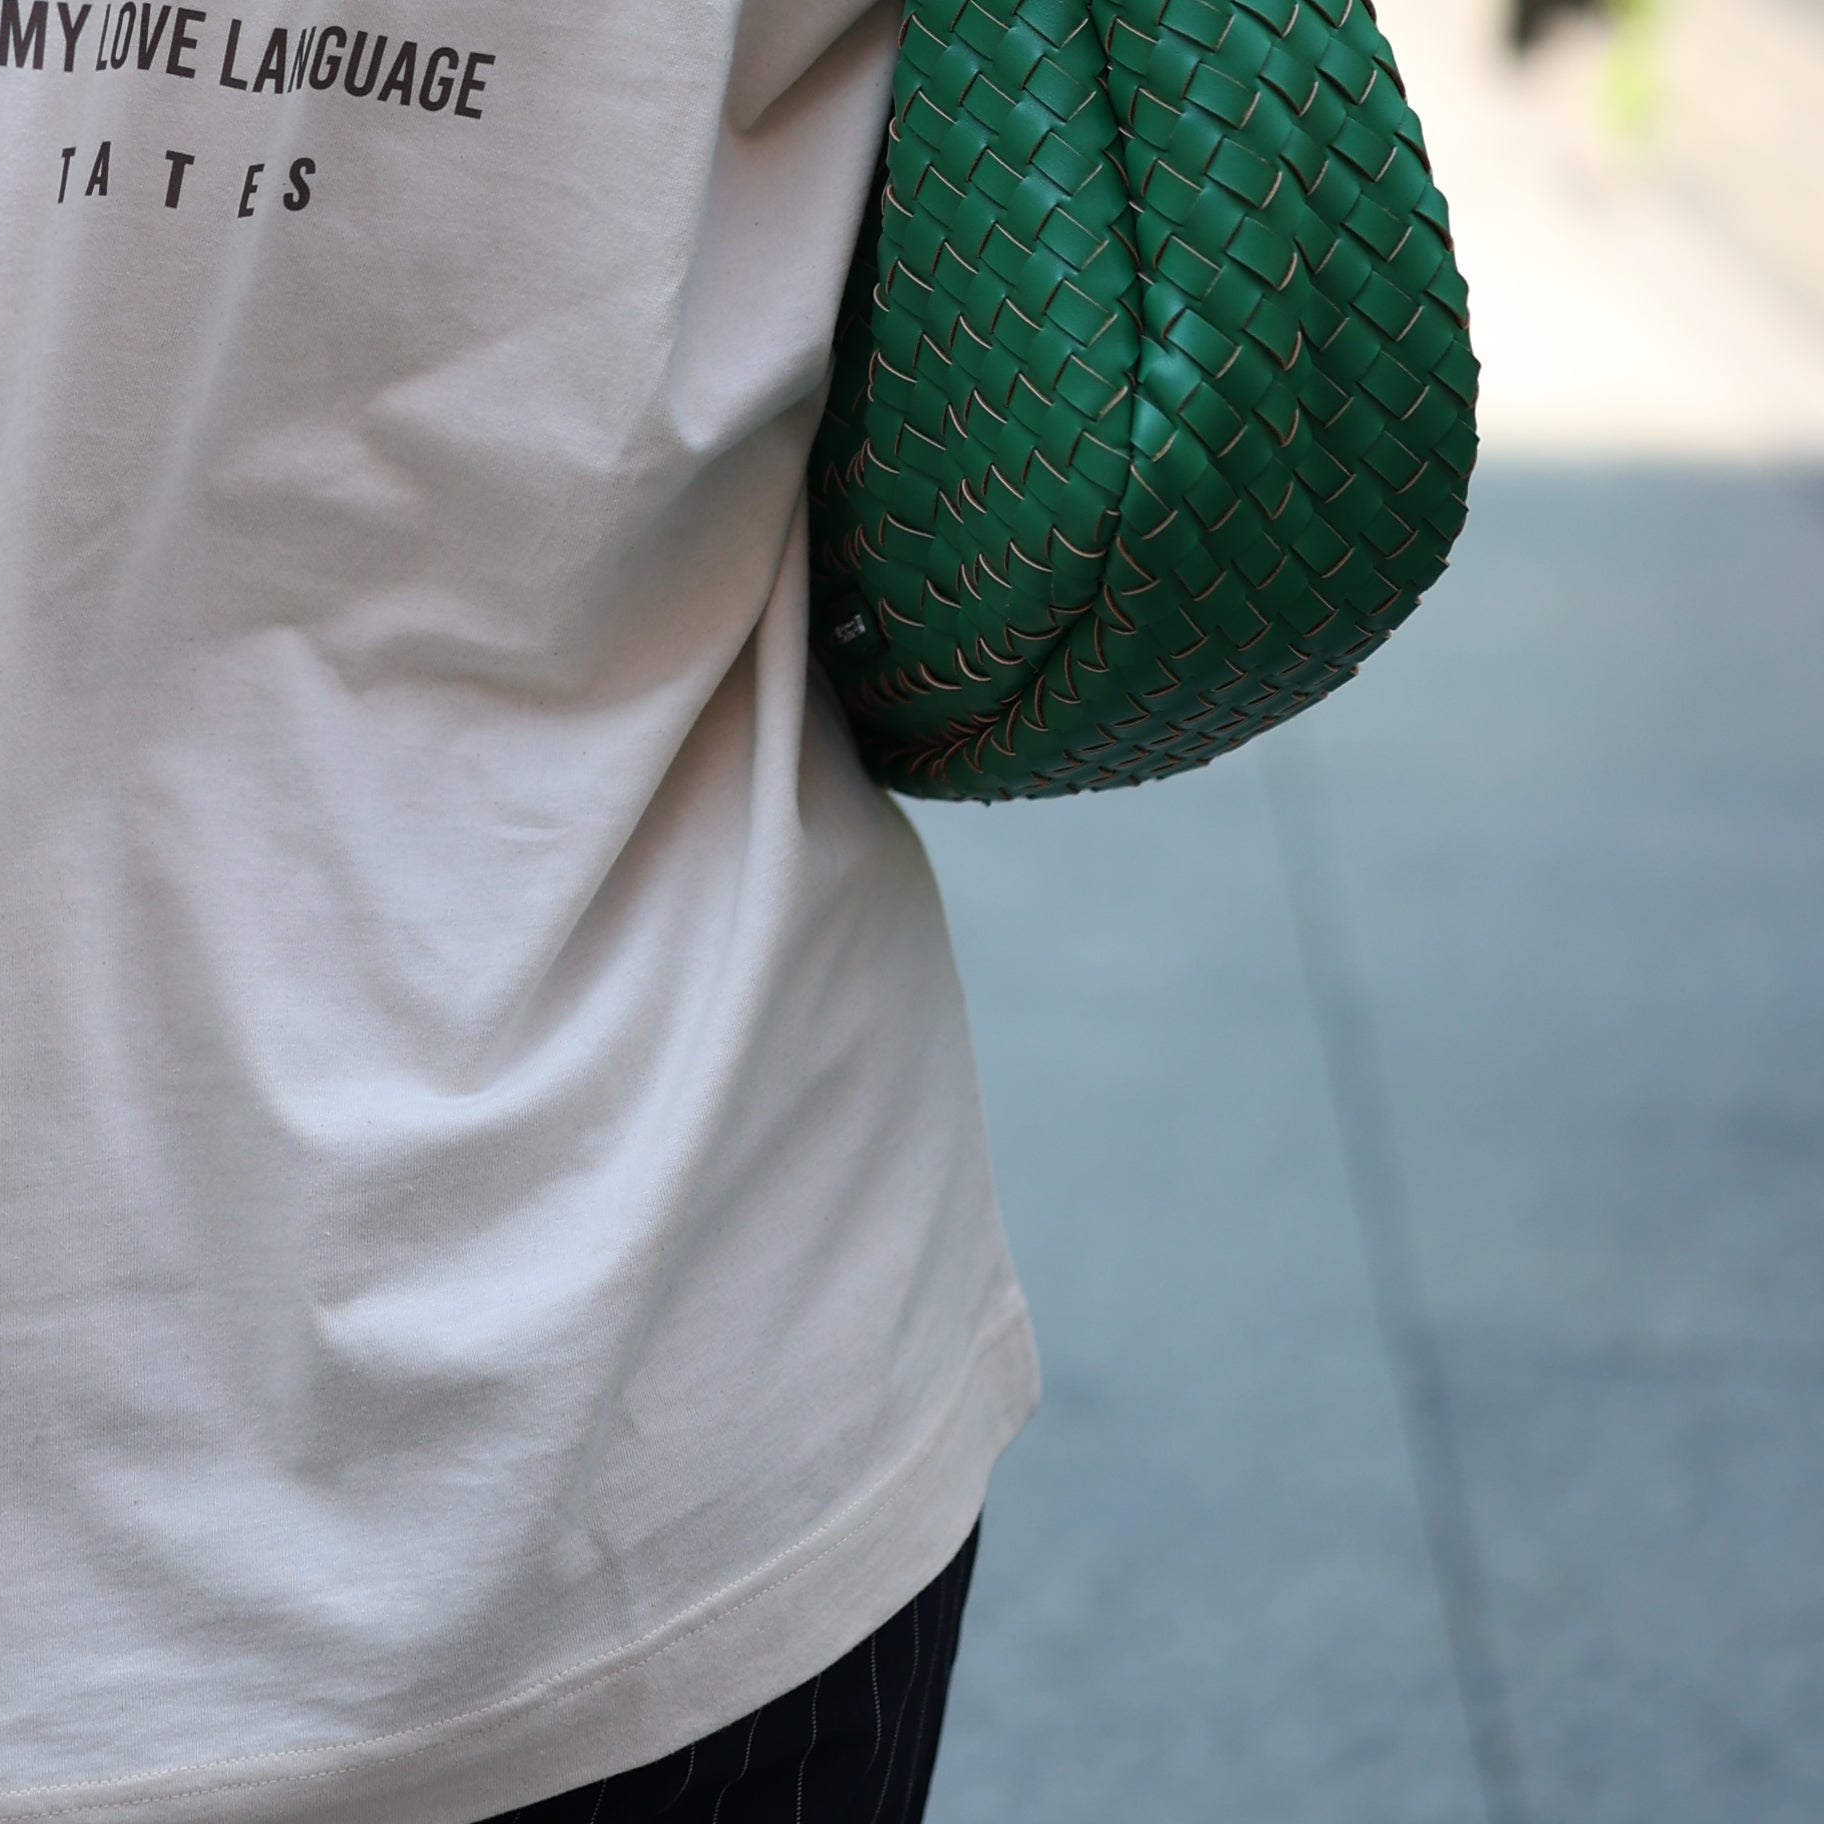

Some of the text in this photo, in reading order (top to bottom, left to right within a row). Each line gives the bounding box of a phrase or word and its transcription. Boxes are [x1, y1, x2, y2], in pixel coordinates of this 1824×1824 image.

[94, 1, 207, 80] LOVE
[218, 17, 497, 121] LANGUAGE
[56, 139, 318, 220] TATES
